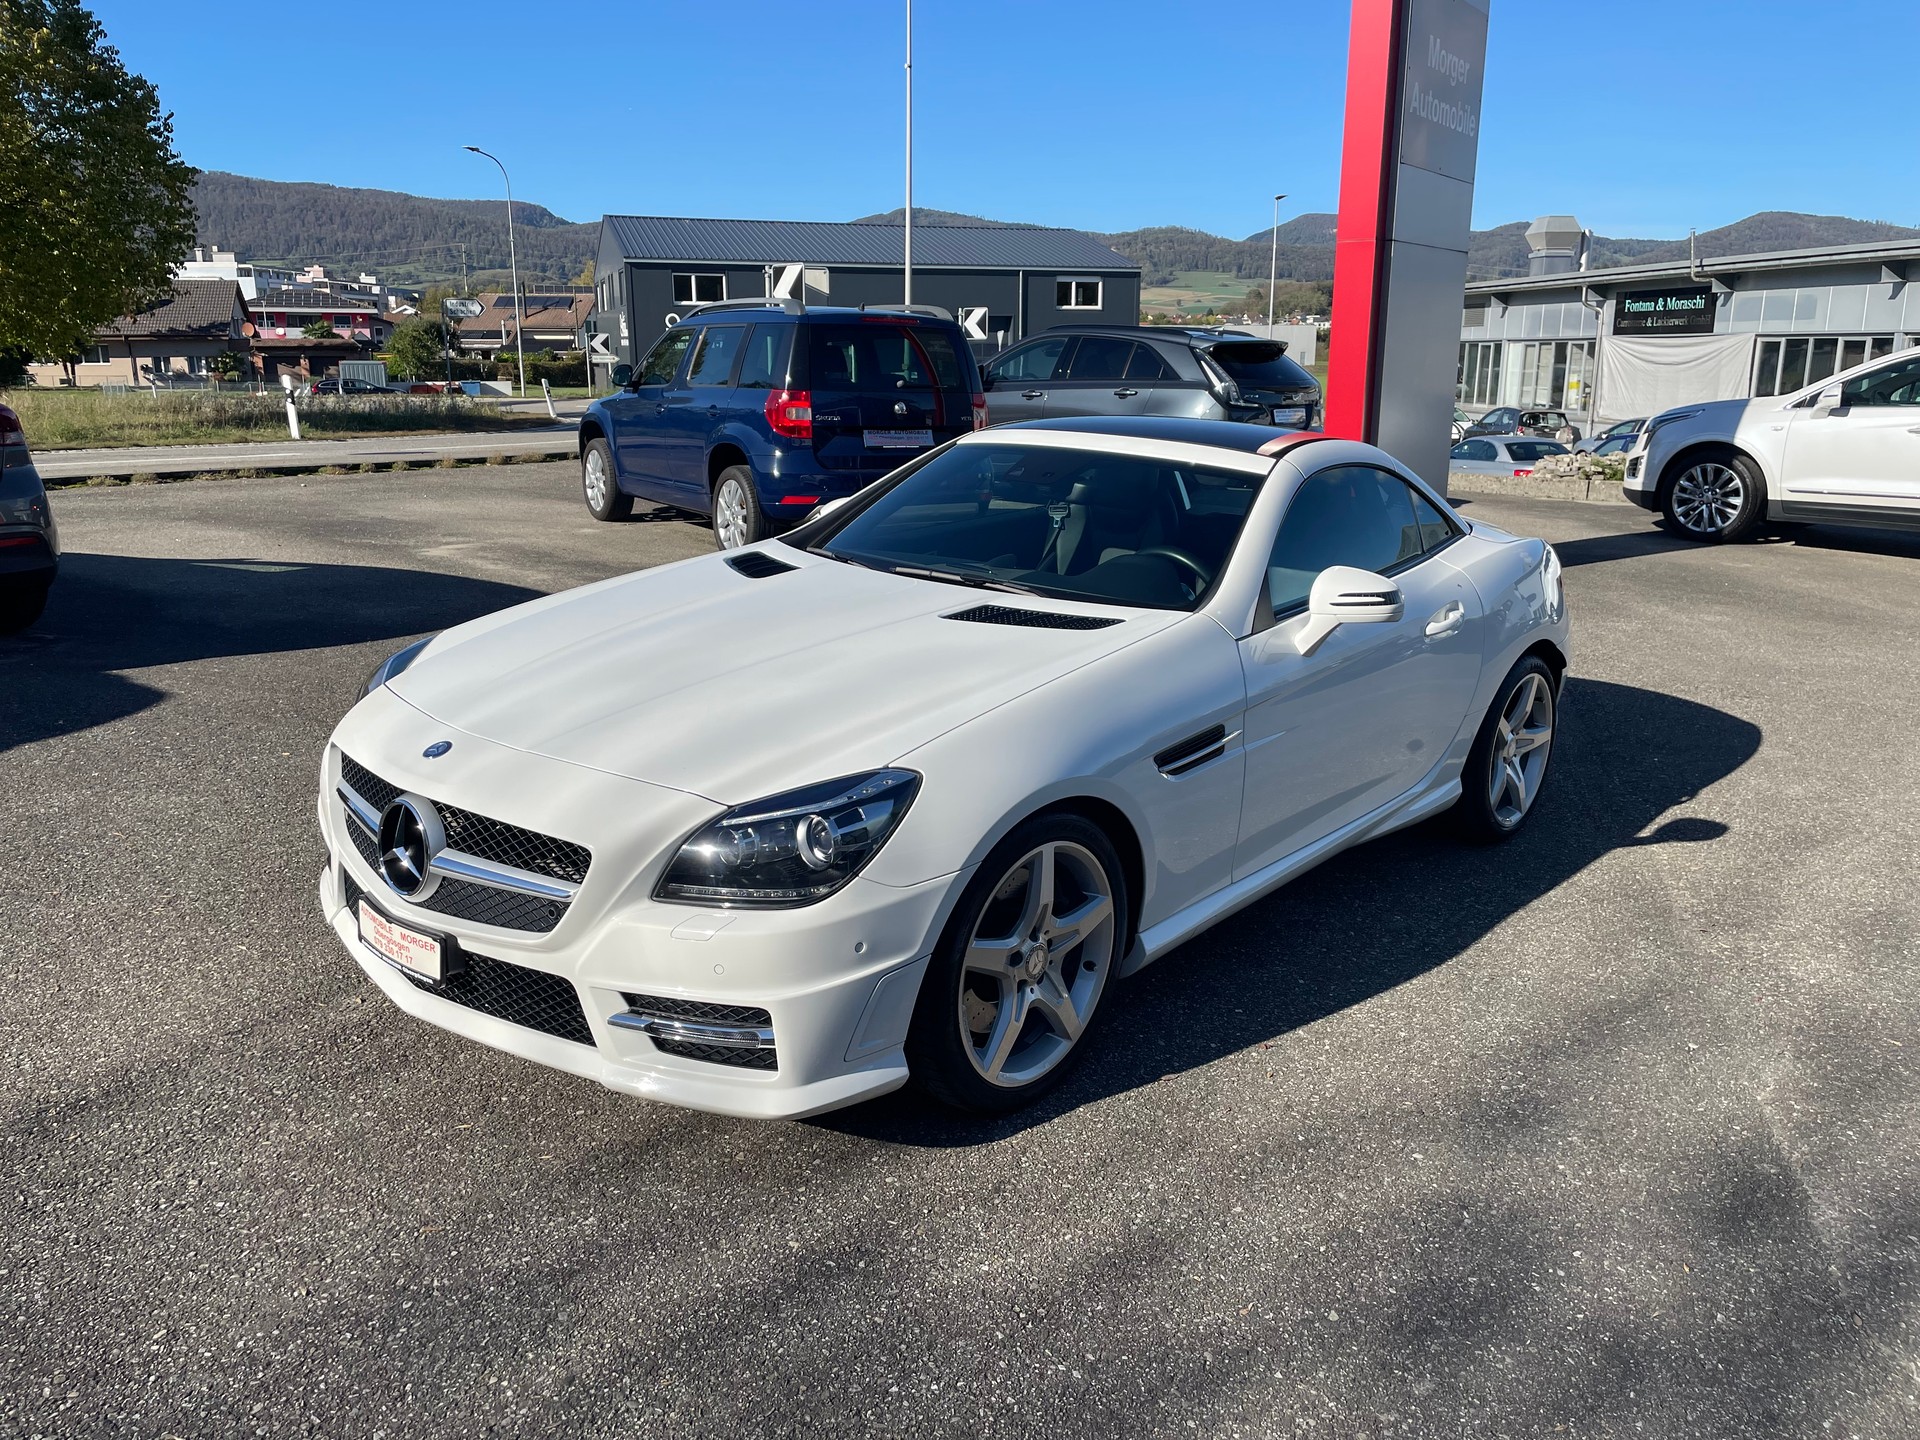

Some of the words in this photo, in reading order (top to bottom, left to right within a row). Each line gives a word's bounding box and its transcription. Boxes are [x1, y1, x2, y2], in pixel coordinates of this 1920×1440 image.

[1427, 34, 1471, 87] Morger
[1409, 82, 1476, 137] Automobile
[1624, 299, 1655, 313] Fontana
[1656, 297, 1664, 311] &
[1666, 294, 1706, 311] Moraschi
[1646, 317, 1653, 327] &
[1690, 314, 1712, 325] GmbH
[360, 904, 394, 936] AUTOMOBILE
[400, 931, 437, 954] MORGER
[396, 950, 404, 961] 17
[405, 955, 413, 965] 17
